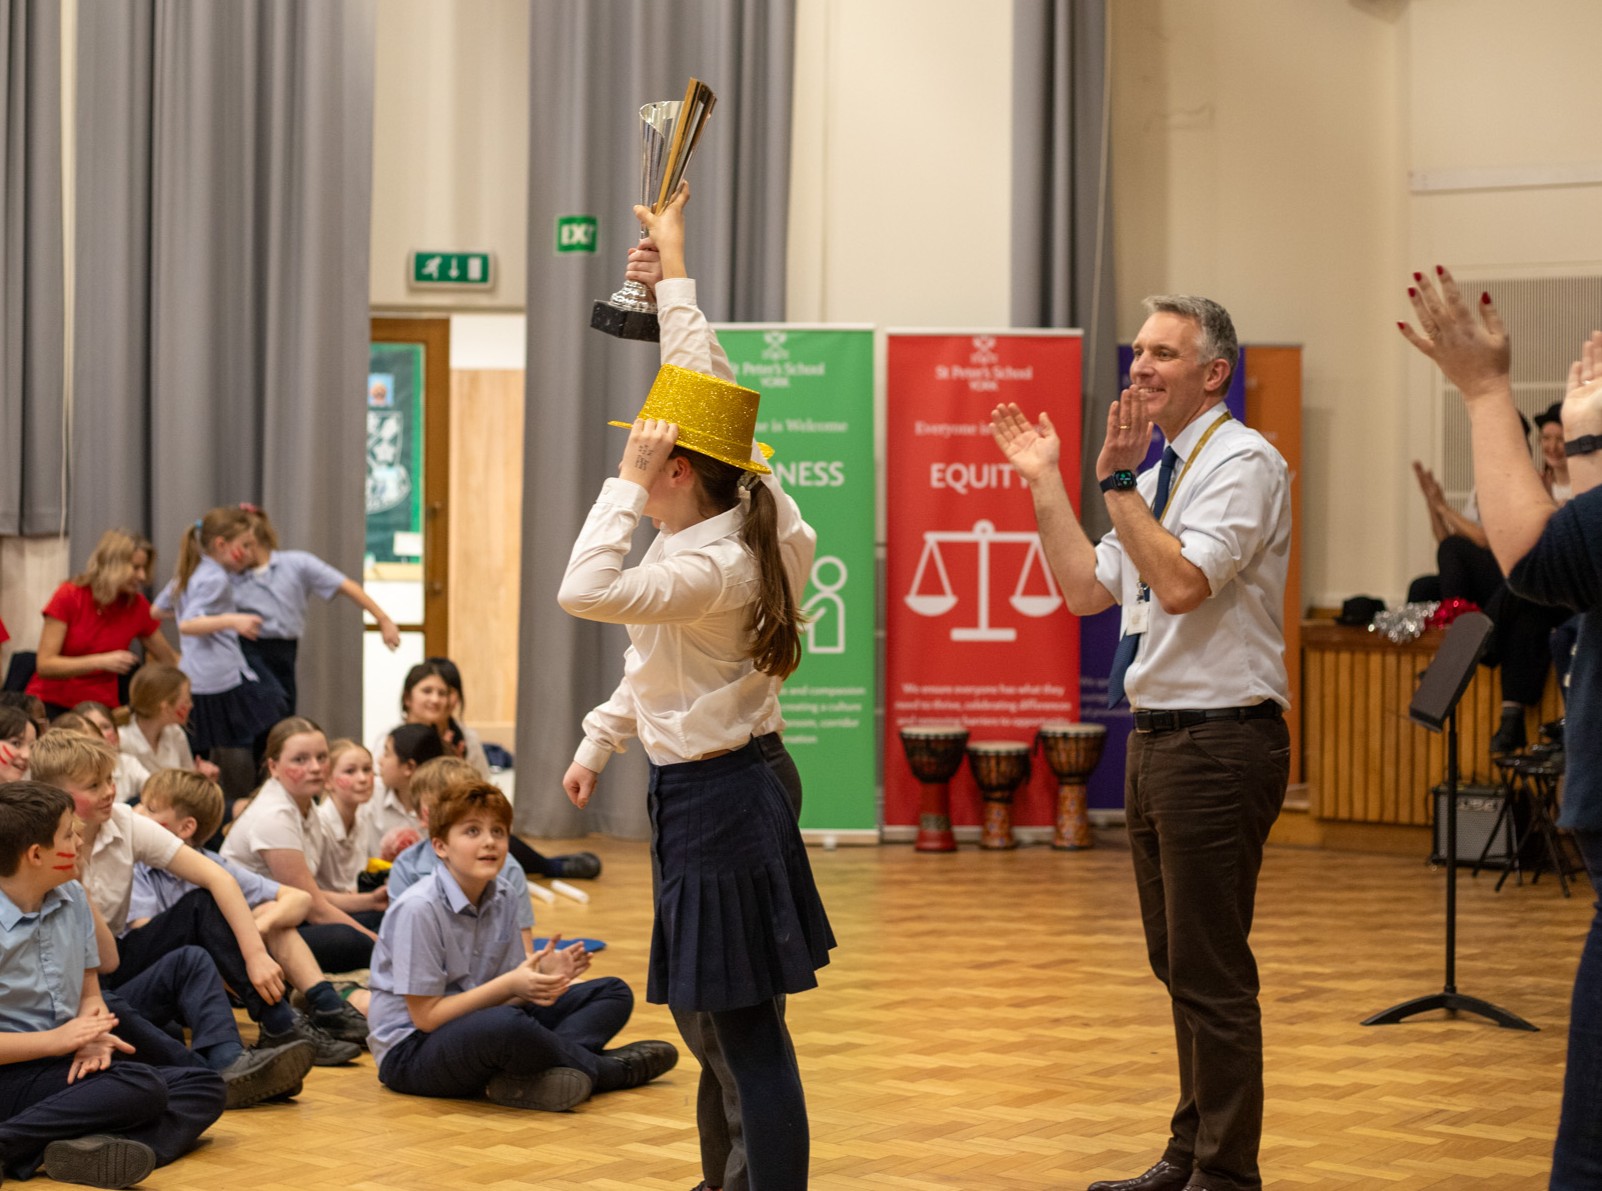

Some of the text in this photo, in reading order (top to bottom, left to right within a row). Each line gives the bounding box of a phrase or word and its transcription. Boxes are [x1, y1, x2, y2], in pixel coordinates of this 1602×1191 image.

[784, 362, 825, 376] School
[992, 364, 1033, 379] School
[785, 418, 848, 432] Welcome
[914, 420, 977, 438] Everyone
